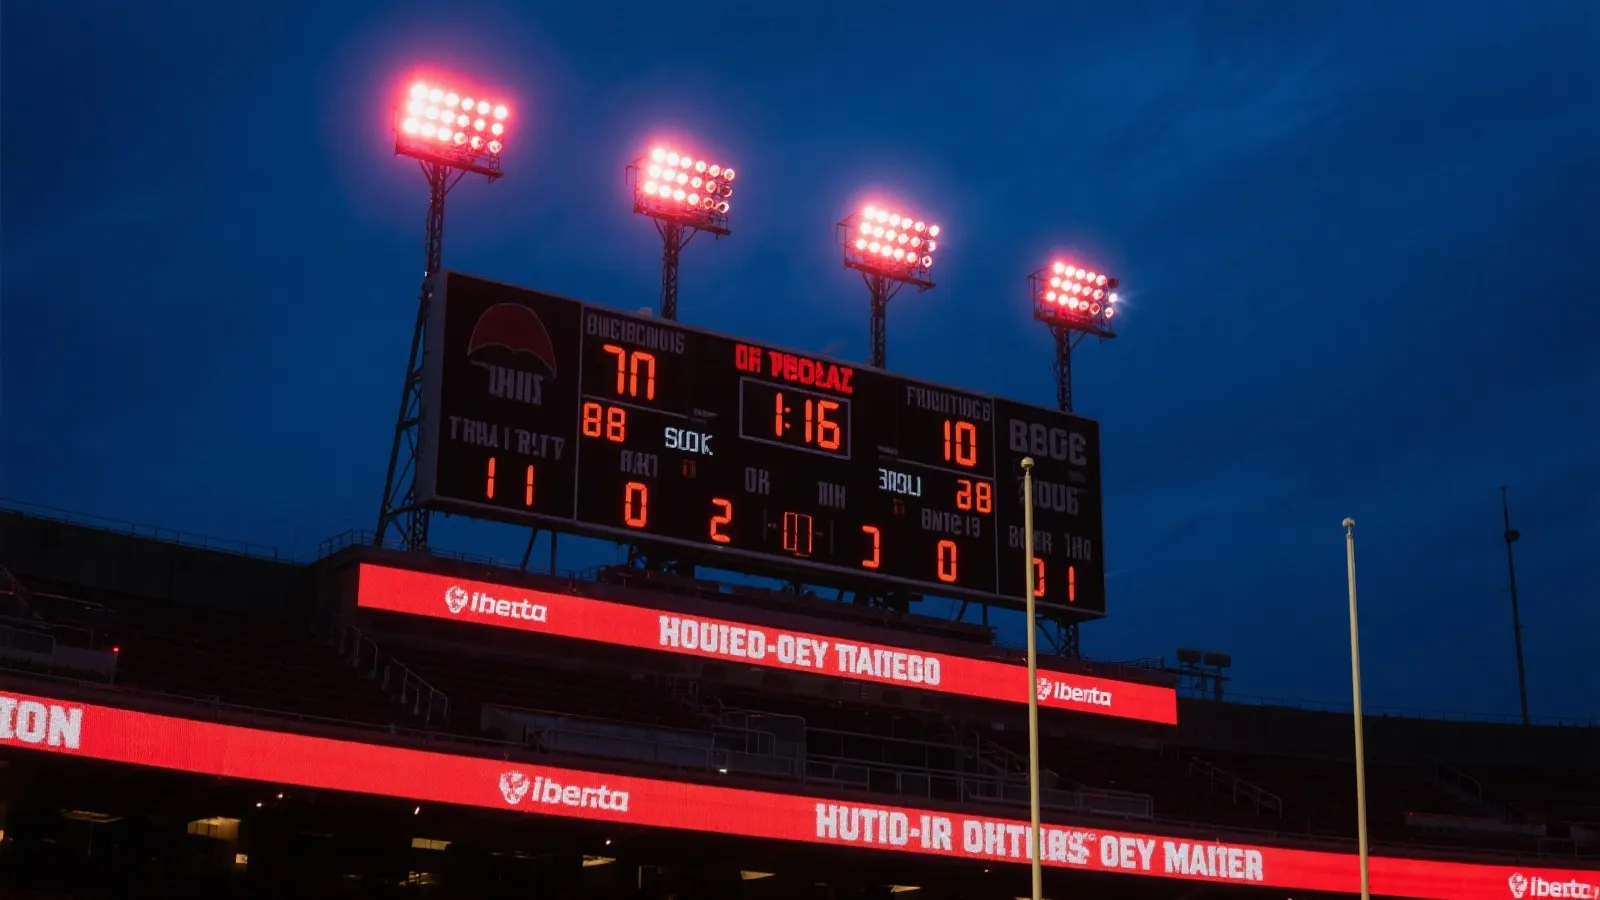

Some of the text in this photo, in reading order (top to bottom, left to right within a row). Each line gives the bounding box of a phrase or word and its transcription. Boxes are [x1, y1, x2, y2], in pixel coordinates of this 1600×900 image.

[582, 400, 627, 443] 88
[775, 391, 842, 450] 1:16
[943, 419, 977, 467] 10
[624, 481, 648, 528] 0
[706, 496, 734, 543] 2
[936, 539, 958, 583] 0
